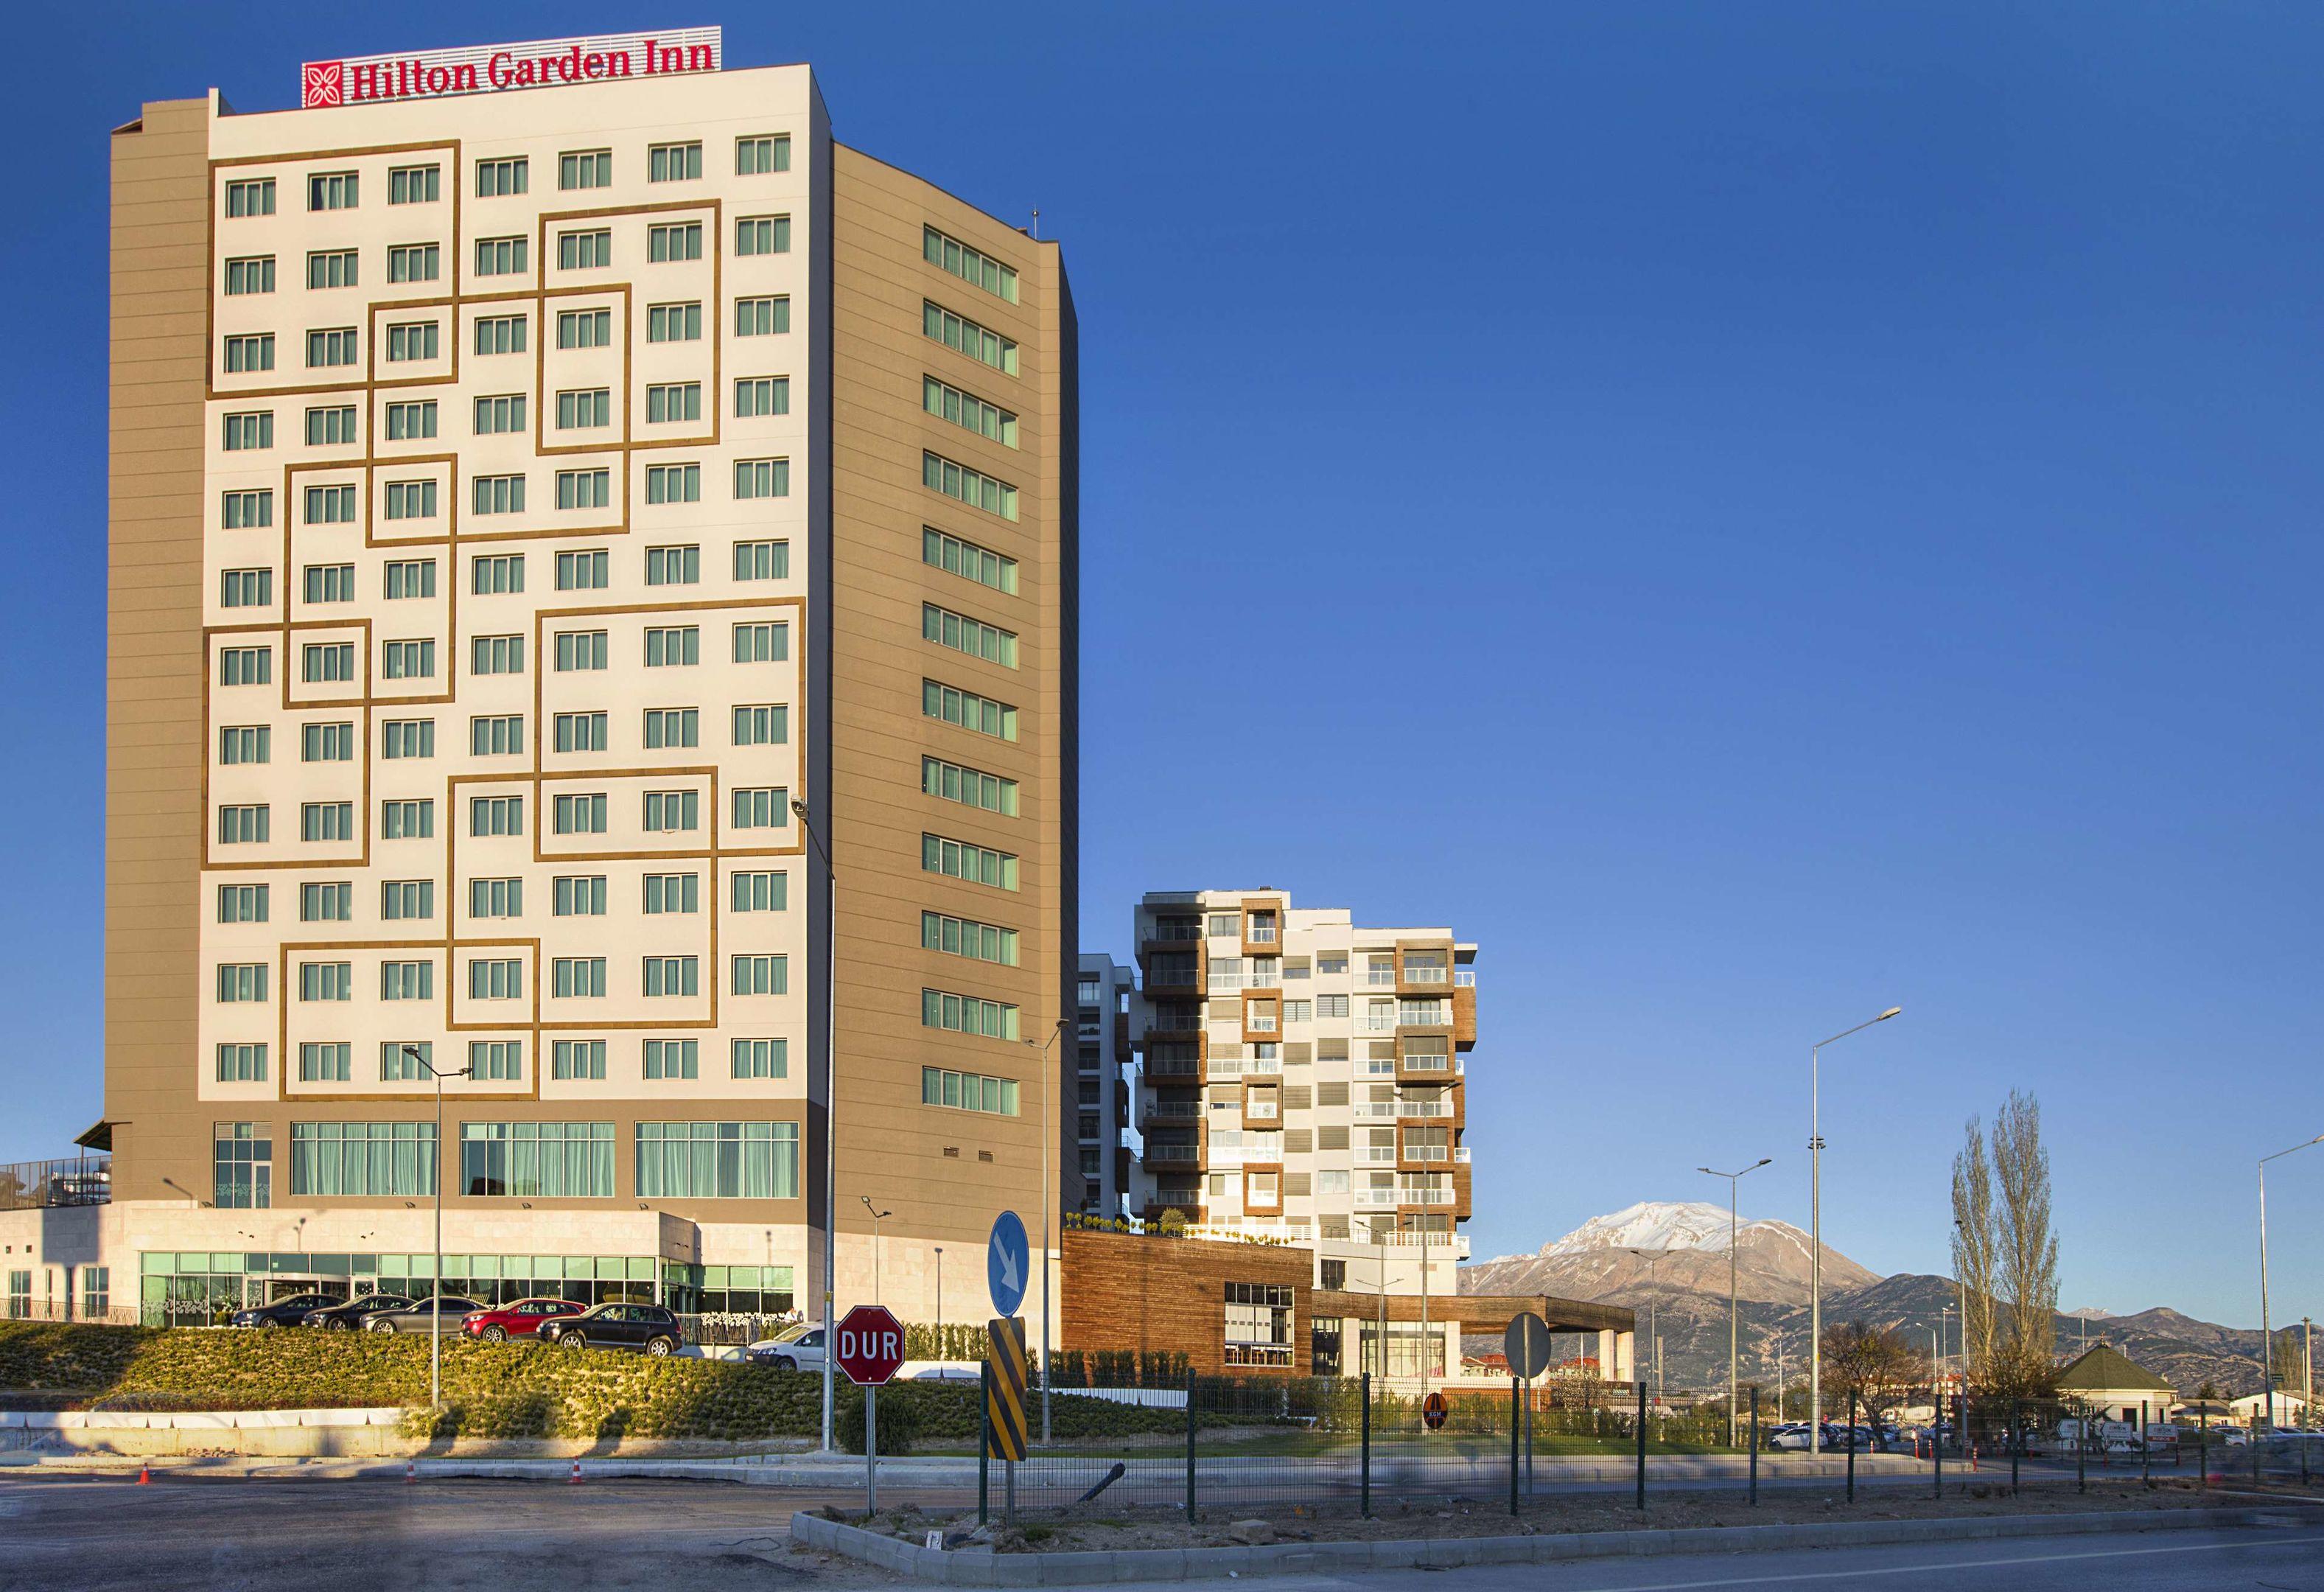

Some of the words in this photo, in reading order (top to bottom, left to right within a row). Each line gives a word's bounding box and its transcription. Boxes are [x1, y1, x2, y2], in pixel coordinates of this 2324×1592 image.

[350, 59, 479, 101] Hilton
[487, 45, 633, 89] Garden
[643, 39, 715, 76] Inn
[841, 1330, 897, 1361] DUR
